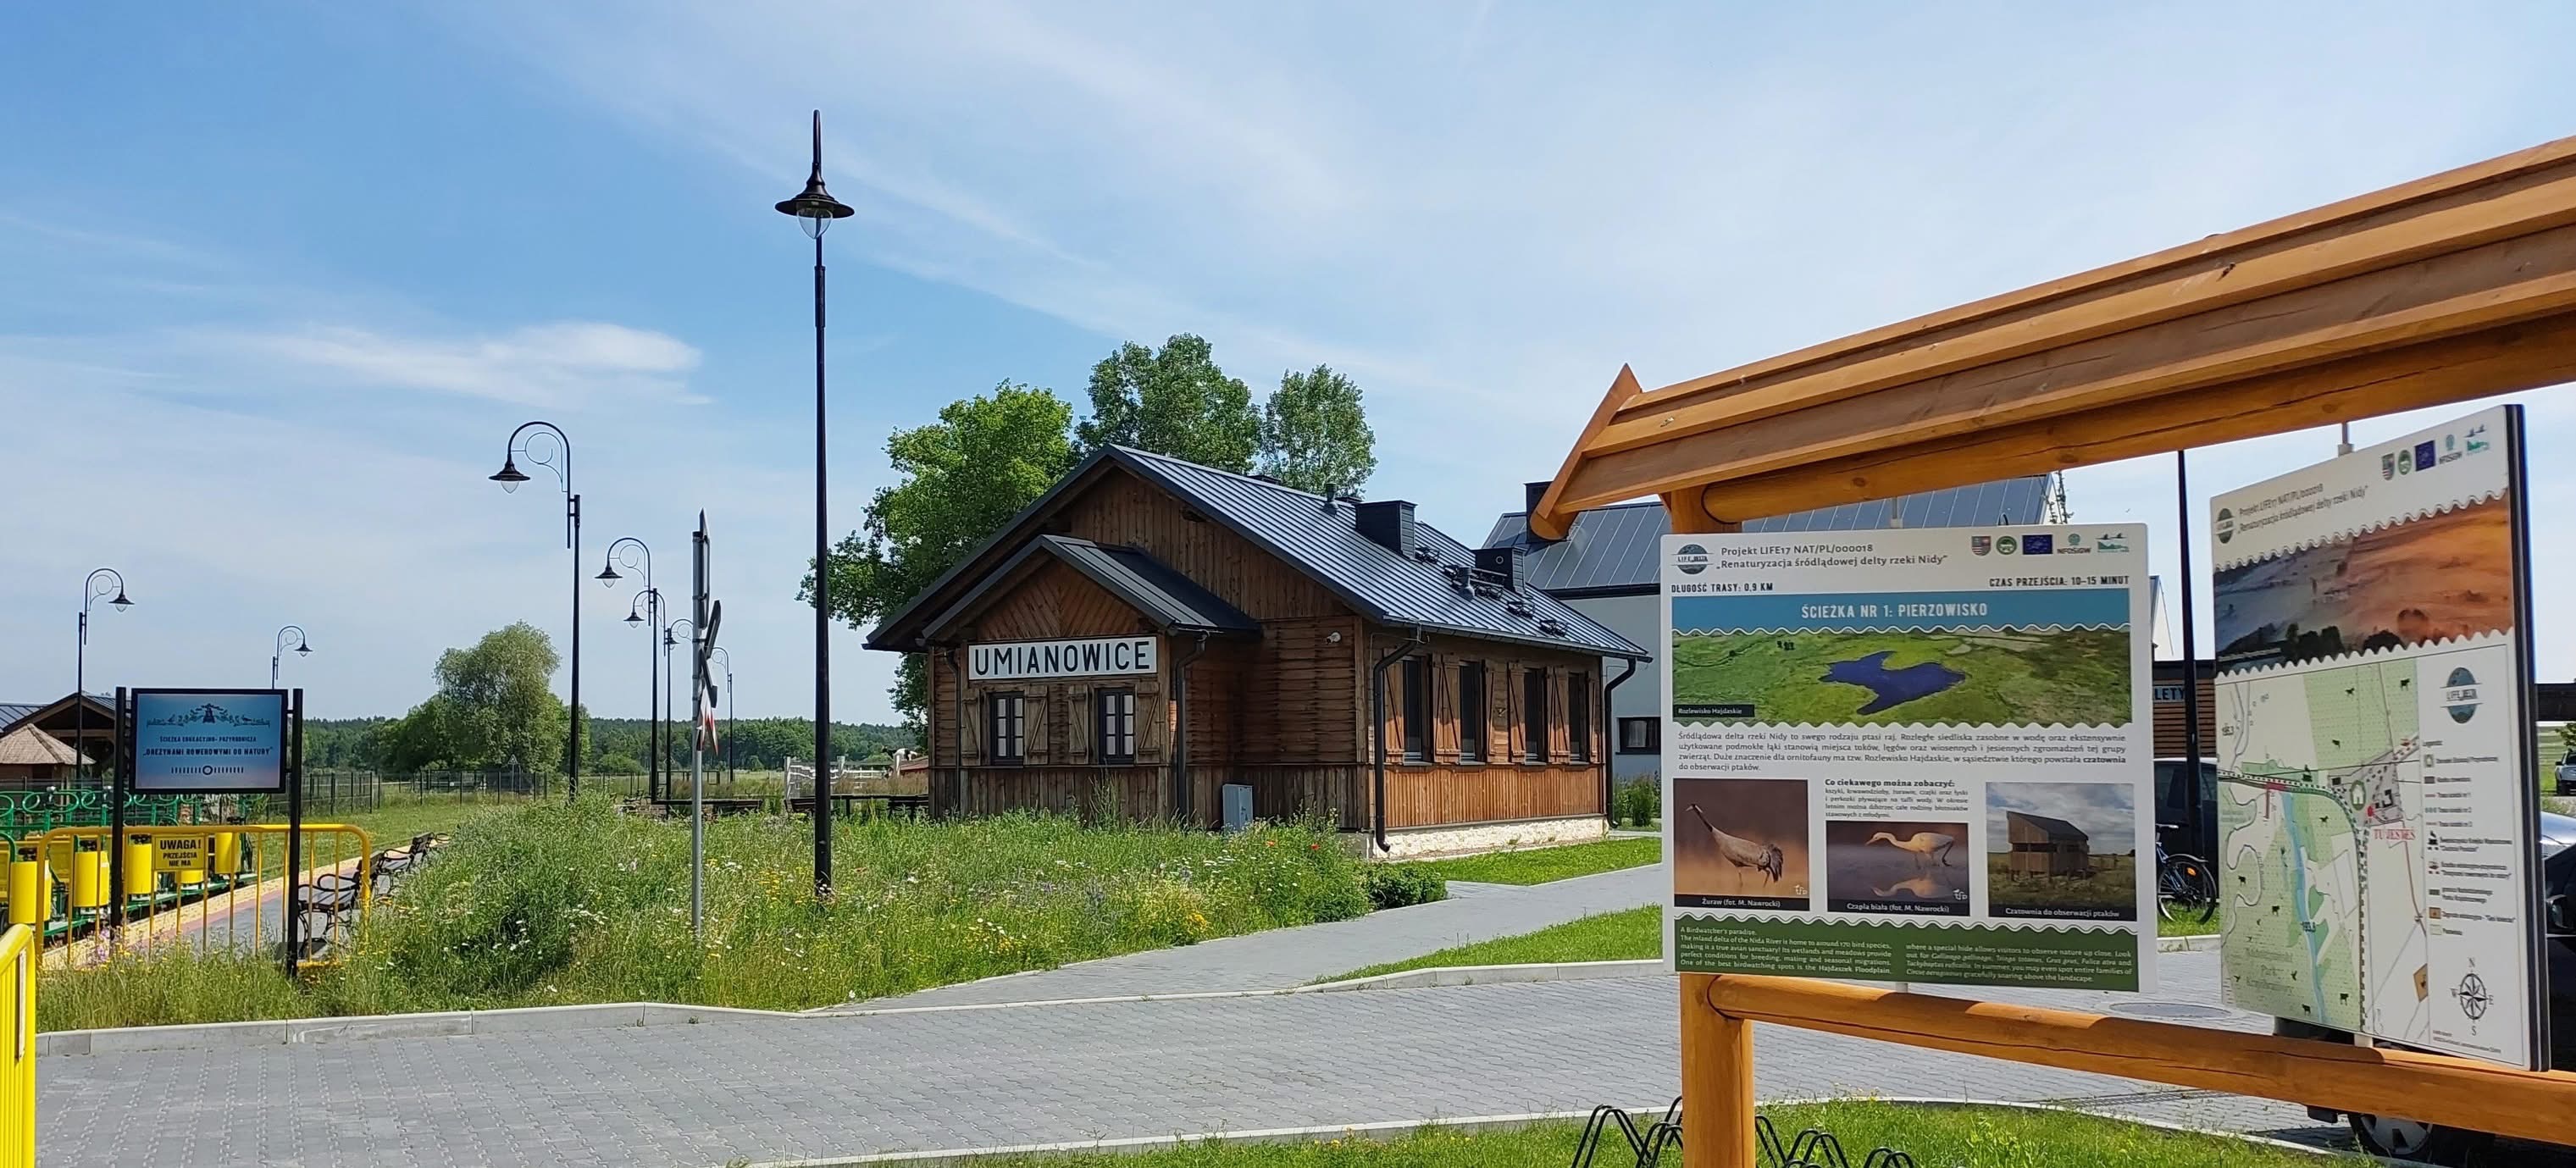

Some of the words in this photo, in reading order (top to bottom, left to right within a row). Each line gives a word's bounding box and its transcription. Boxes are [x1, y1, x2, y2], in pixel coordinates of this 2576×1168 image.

[1721, 546, 1759, 557] Projekt
[1759, 545, 1793, 555] LIFE17
[1793, 544, 1875, 554] NAT/PL/000018
[1796, 556, 1857, 568] śródlądowej
[1860, 556, 1886, 567] delty
[1890, 556, 1914, 564] rzeki
[1990, 578, 2013, 587] CZAS
[2016, 577, 2067, 586] PRZEJŚCIA:
[2101, 575, 2128, 584] MINUT
[1671, 583, 1707, 593] DŁUGOŚĆ
[1711, 583, 1741, 592] TRASY:
[1760, 583, 1773, 591] KM
[1802, 604, 1854, 618] ŚCIEŻKA
[1860, 605, 1877, 617] NR
[1884, 605, 1892, 617] 1:
[1898, 603, 1986, 617] PIERZOWISKO
[975, 641, 1150, 676] UMIANOWICE
[1829, 733, 1859, 741] rodzaju
[1884, 733, 1897, 742] raj.
[1901, 733, 1935, 742] Rozległe
[2023, 734, 2046, 743] wodę
[2069, 734, 2126, 743] ekstensywnie
[1821, 744, 1852, 752] miejsca
[1883, 744, 1908, 752] lęgów
[1930, 745, 1977, 753] wiosennych
[1986, 745, 2030, 754] jesiennych
[2087, 745, 2099, 754] tej
[2011, 756, 2042, 764] którego
[2044, 756, 2081, 764] powstała
[1836, 779, 1881, 788] ciekawego
[1702, 898, 1722, 908] Żuraw
